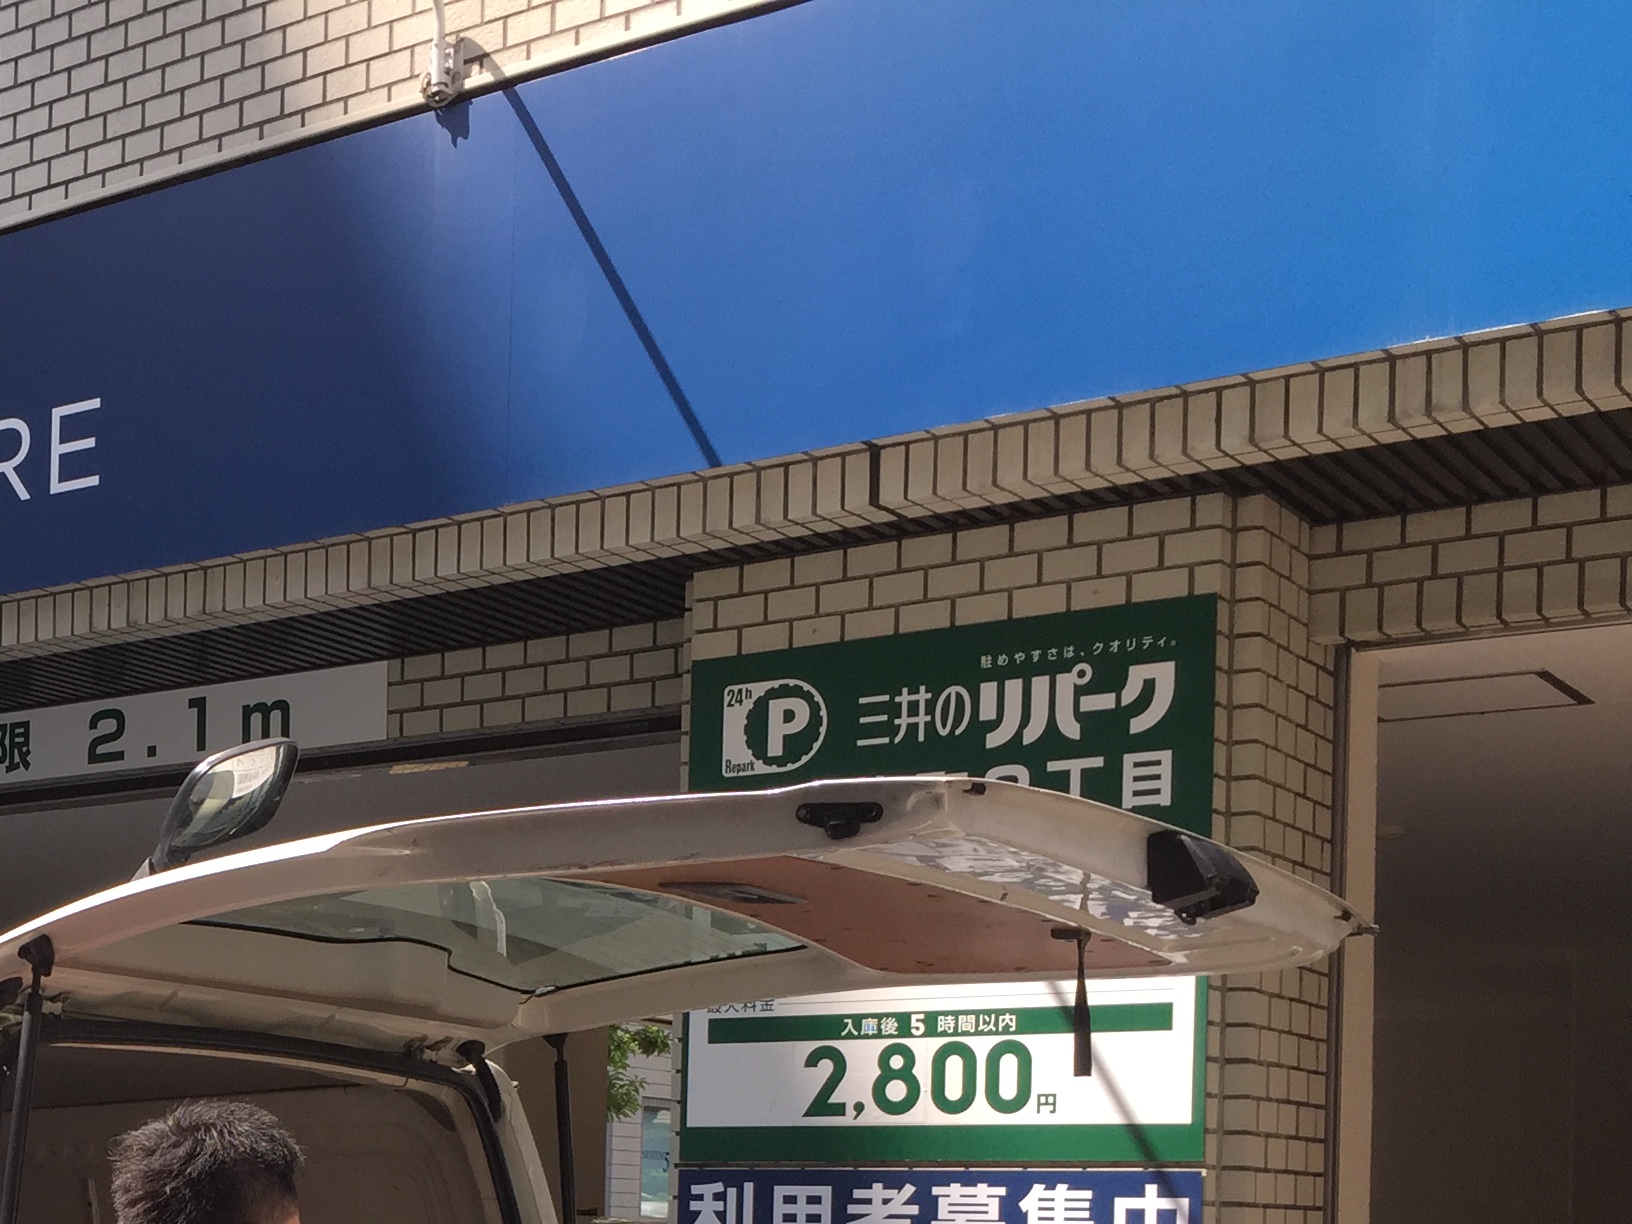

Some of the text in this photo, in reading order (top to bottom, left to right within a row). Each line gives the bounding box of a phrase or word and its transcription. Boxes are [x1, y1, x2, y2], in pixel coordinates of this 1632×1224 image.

[87, 696, 292, 766] 2.1m
[767, 697, 810, 757] P
[856, 662, 1176, 749] 三井のリパーク
[725, 759, 756, 775] Repark
[841, 1013, 1017, 1036] 入庫後 5 時間以内
